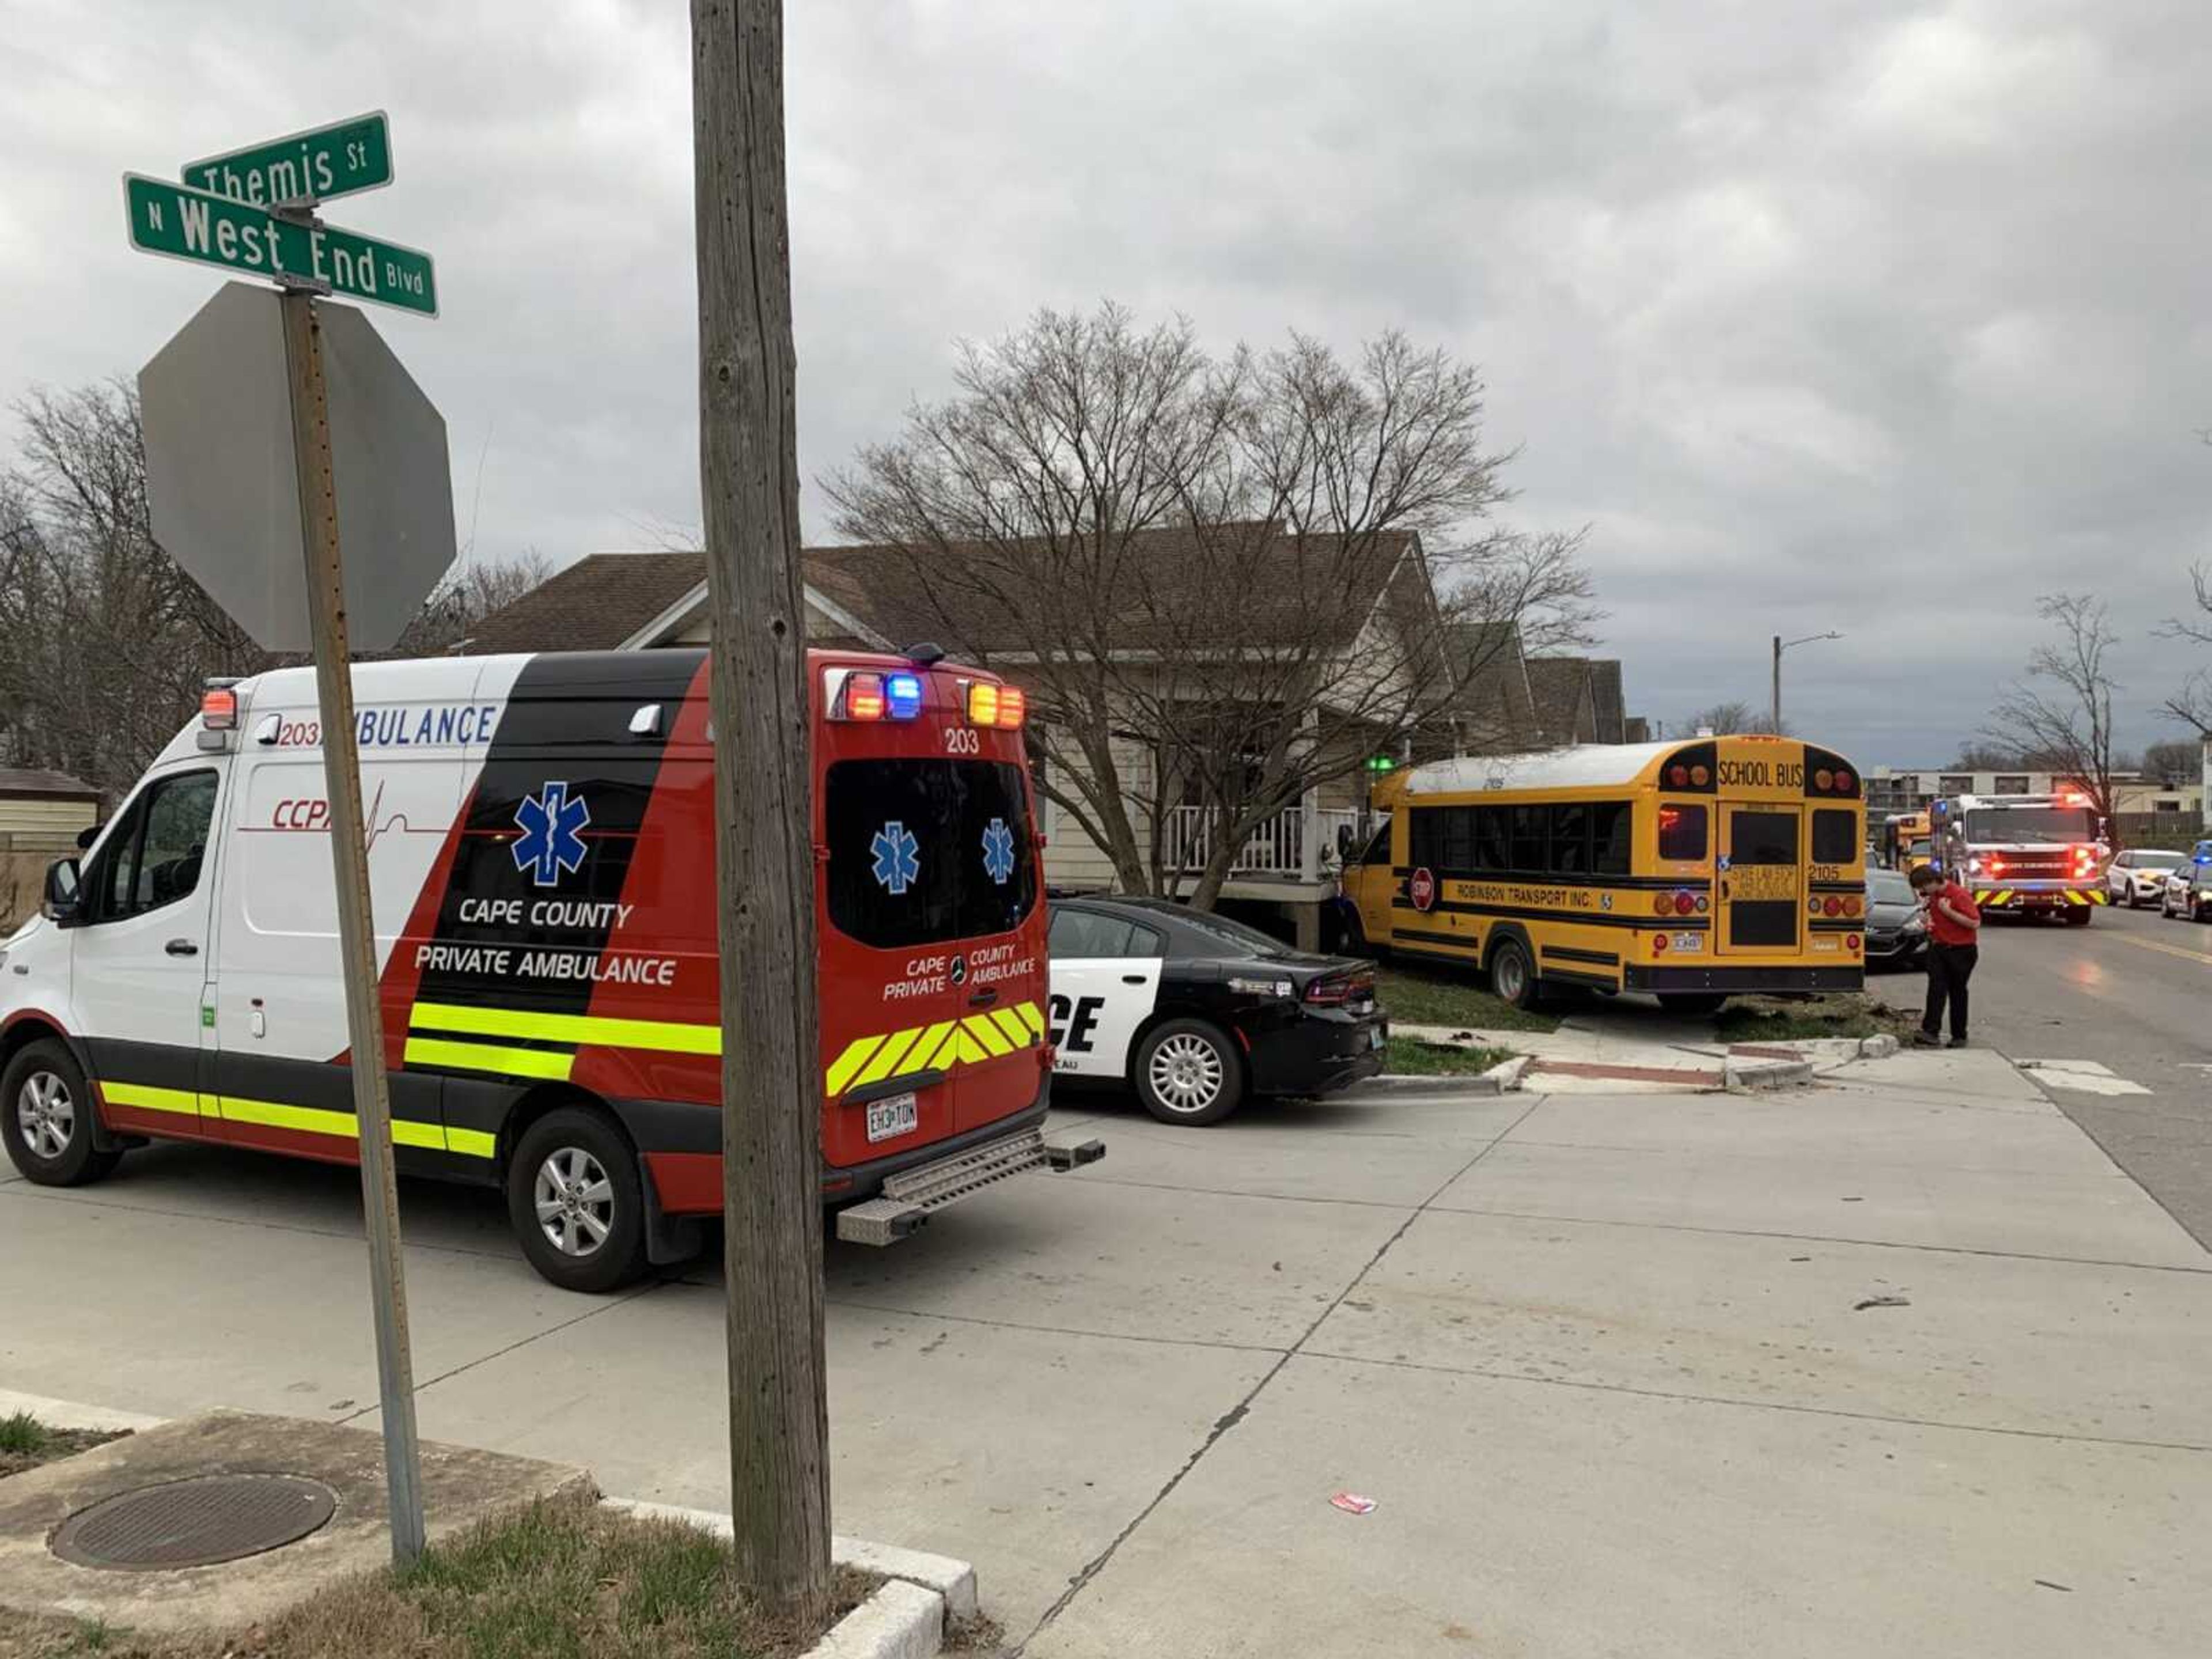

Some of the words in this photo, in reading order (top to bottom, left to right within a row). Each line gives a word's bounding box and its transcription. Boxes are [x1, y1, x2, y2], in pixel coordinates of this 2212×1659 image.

[204, 144, 333, 206] Themis
[347, 142, 368, 171] St
[147, 202, 164, 231] N
[177, 196, 284, 271] West
[310, 231, 378, 294] End
[387, 262, 424, 294] Blvd
[279, 722, 319, 746] 203
[319, 707, 497, 745] BULANCE
[945, 728, 979, 753] 203
[1719, 761, 1772, 787] SCHOOL
[1777, 763, 1803, 788] BUS
[1808, 865, 1839, 880] 2105
[1457, 884, 1505, 901] ROBINSON
[1509, 888, 1566, 907] TRANSPORT
[460, 899, 522, 923] CAPE
[531, 902, 633, 929] COUNTY
[415, 946, 510, 974] PRIVATE
[518, 953, 677, 984] AMBULANCE
[907, 956, 946, 976] CAPE
[969, 944, 1015, 966] COUNTY
[883, 975, 946, 1001] PRIVATE
[971, 958, 1035, 985] AMBULANCE
